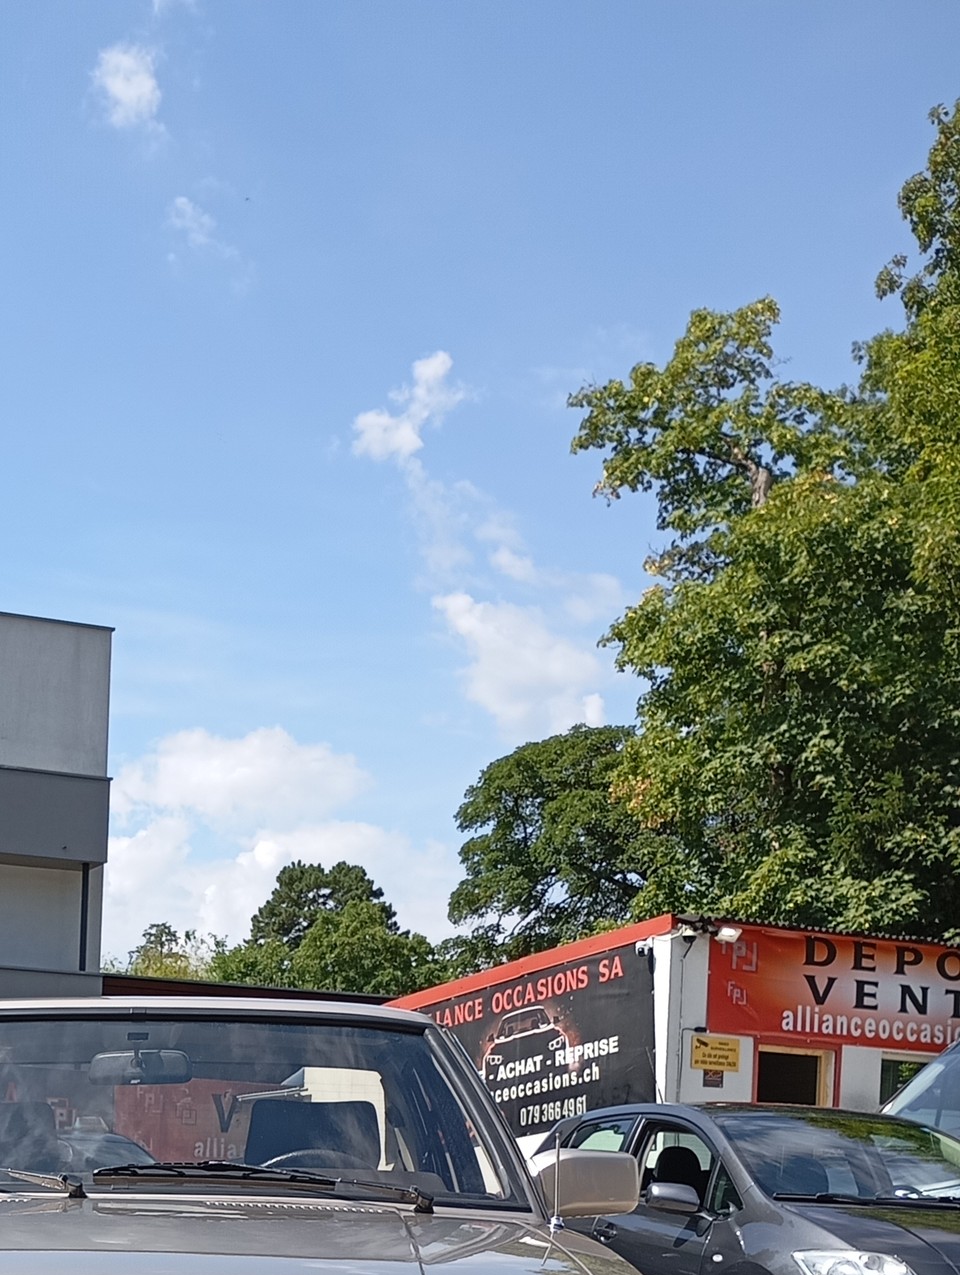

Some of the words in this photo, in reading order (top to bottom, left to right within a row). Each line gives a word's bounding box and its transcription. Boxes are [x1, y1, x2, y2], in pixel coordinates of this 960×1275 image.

[492, 966, 589, 1014] OCCASIONS
[598, 955, 623, 983] SA
[496, 1054, 544, 1082] ACHAT
[554, 1035, 619, 1067] REPRISE
[490, 1062, 600, 1103] ceoccasions.ch
[520, 1105, 540, 1127] 079
